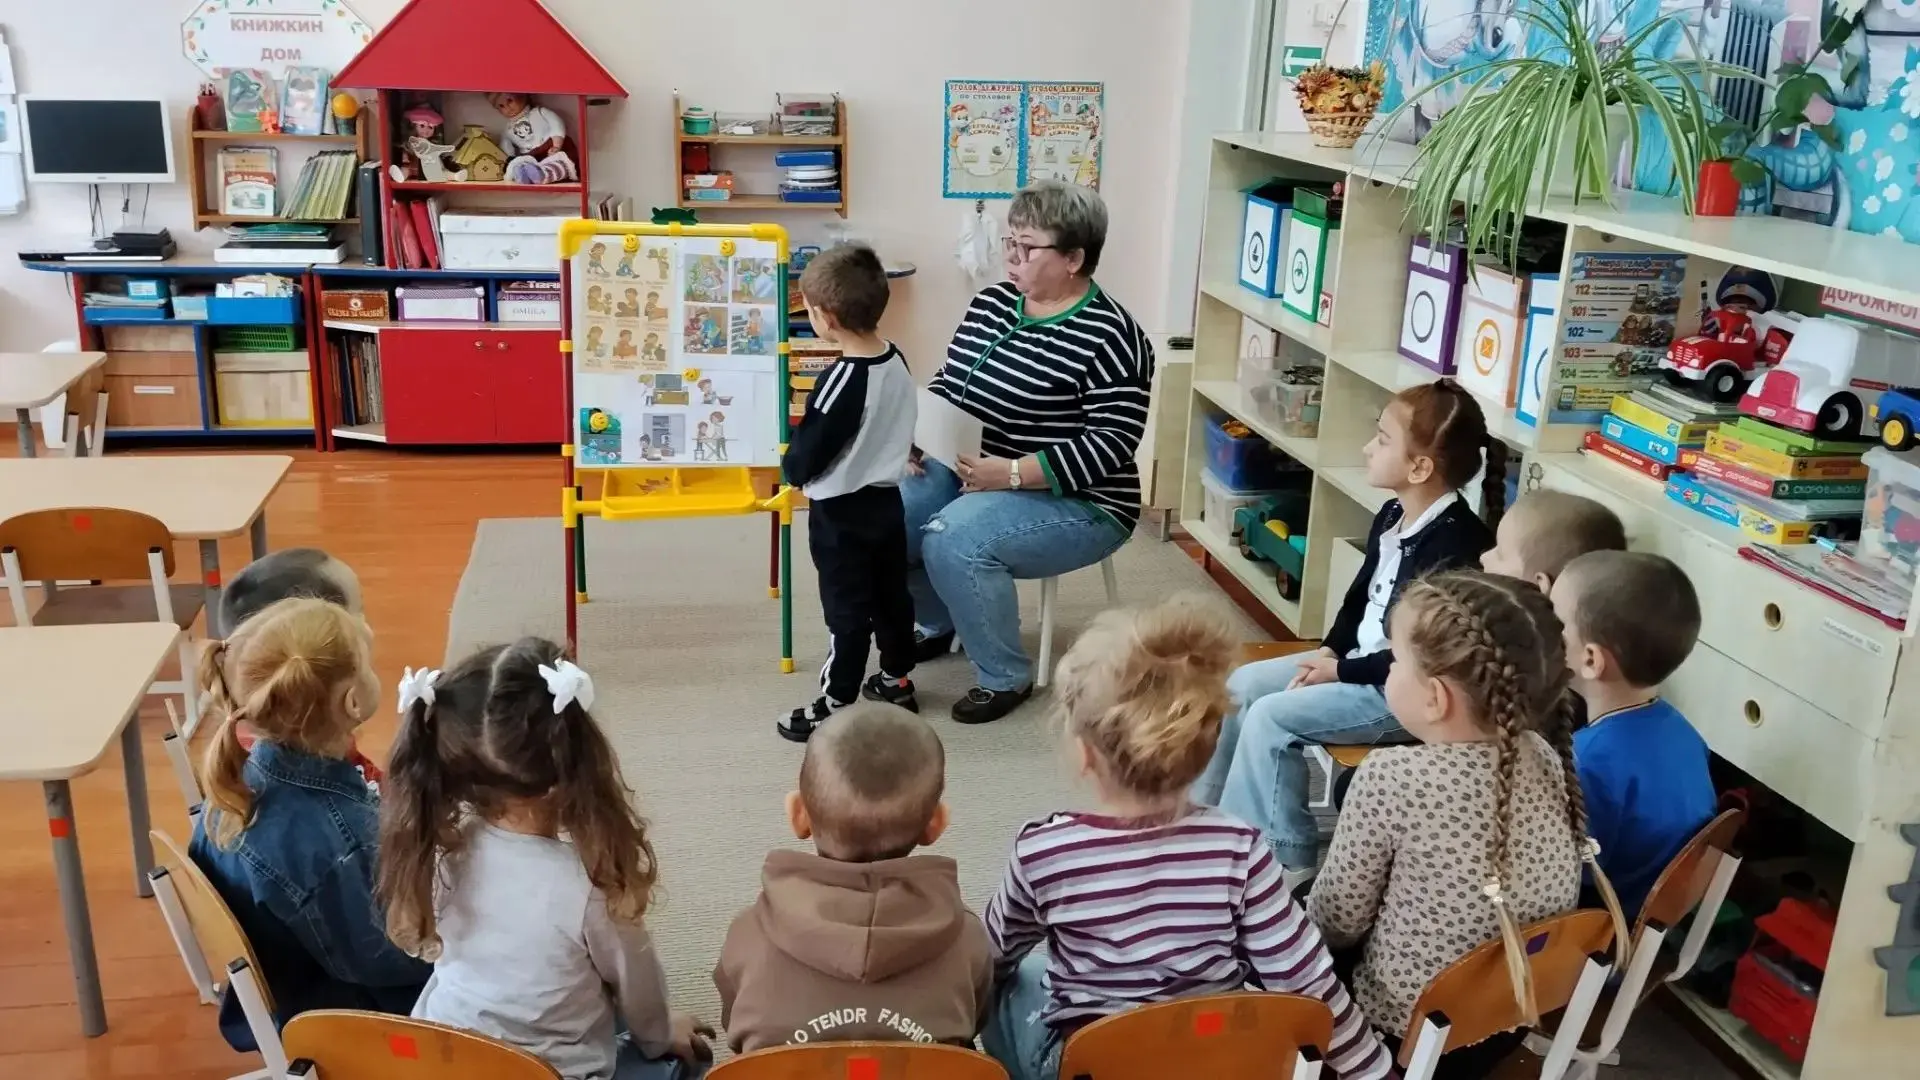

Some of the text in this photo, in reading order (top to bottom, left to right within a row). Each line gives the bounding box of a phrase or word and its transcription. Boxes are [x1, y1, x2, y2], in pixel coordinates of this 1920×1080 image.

[230, 18, 324, 33] КНИЖКИН
[260, 47, 302, 61] ДОМ
[1575, 284, 1590, 295] 112
[1571, 306, 1586, 317] 101
[1567, 327, 1584, 338] 102
[1563, 347, 1581, 358] 103
[1560, 368, 1577, 379] 104
[808, 1007, 867, 1034] TENDR
[877, 1008, 937, 1044] FASHIO
